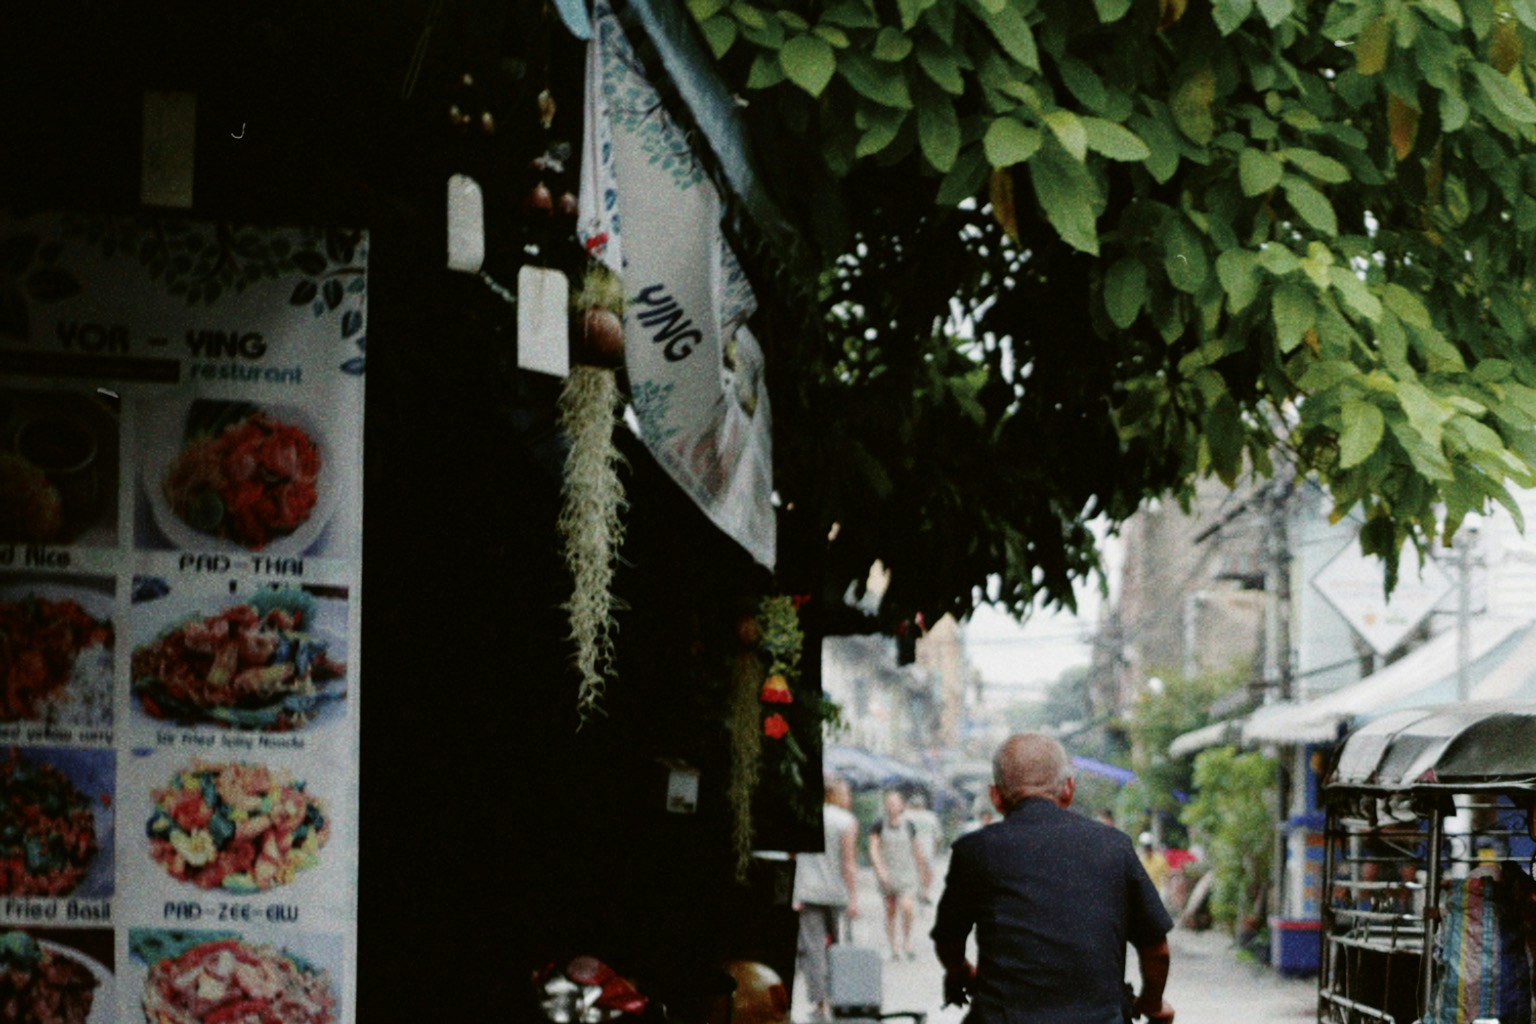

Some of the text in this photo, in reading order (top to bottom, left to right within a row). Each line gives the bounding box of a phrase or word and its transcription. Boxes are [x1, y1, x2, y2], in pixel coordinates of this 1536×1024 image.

[634, 284, 702, 362] YING
[186, 330, 266, 359] YING
[5, 900, 110, 921] Fried Basil
